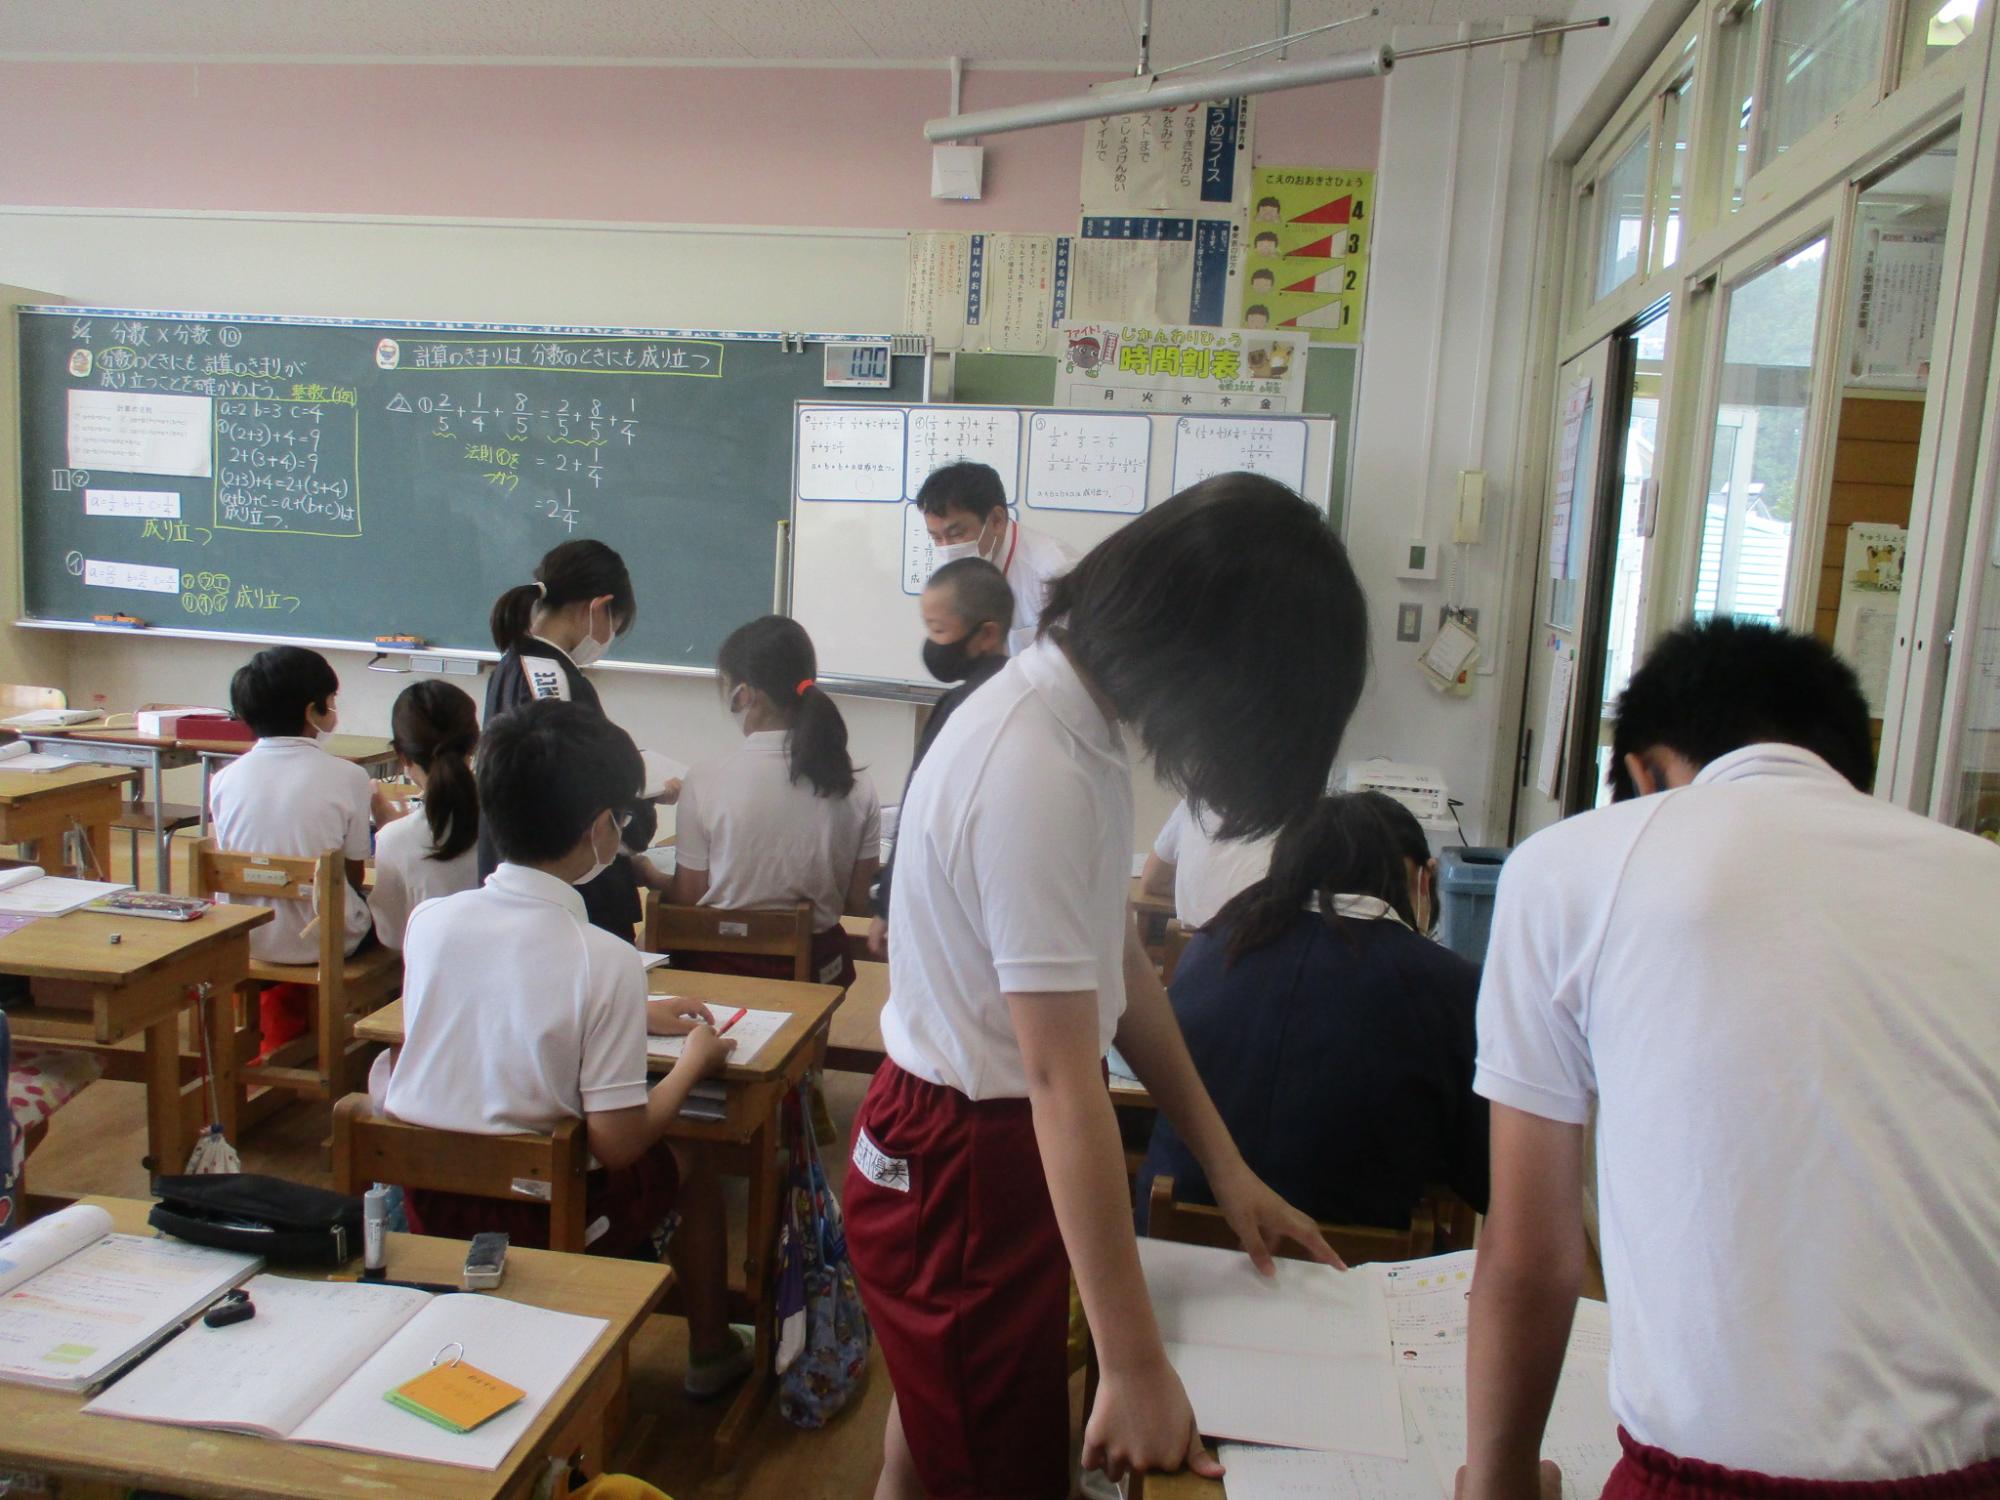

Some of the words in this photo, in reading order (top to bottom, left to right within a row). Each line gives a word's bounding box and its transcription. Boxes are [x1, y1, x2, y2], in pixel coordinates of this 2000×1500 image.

[1160, 104, 1177, 151] をみて
[1180, 103, 1199, 187] なずきながら
[1206, 110, 1225, 182] うめライス
[1265, 174, 1364, 188] こえのおおきさひょう
[1352, 201, 1364, 220] 4
[1349, 234, 1360, 254] 3
[967, 235, 983, 325] きほんのおたずね
[1345, 270, 1357, 290] 2
[1343, 305, 1350, 325] 1
[1121, 326, 1242, 347] じかんわりひょう
[1119, 344, 1241, 380] 時間割表
[1104, 389, 1114, 401] 月
[1142, 391, 1153, 403] 火
[1181, 394, 1192, 405] 水
[1220, 396, 1231, 407] 木
[1260, 398, 1271, 410] 金
[141, 519, 213, 545] 成り立つ
[235, 584, 300, 614] 成り立つ
